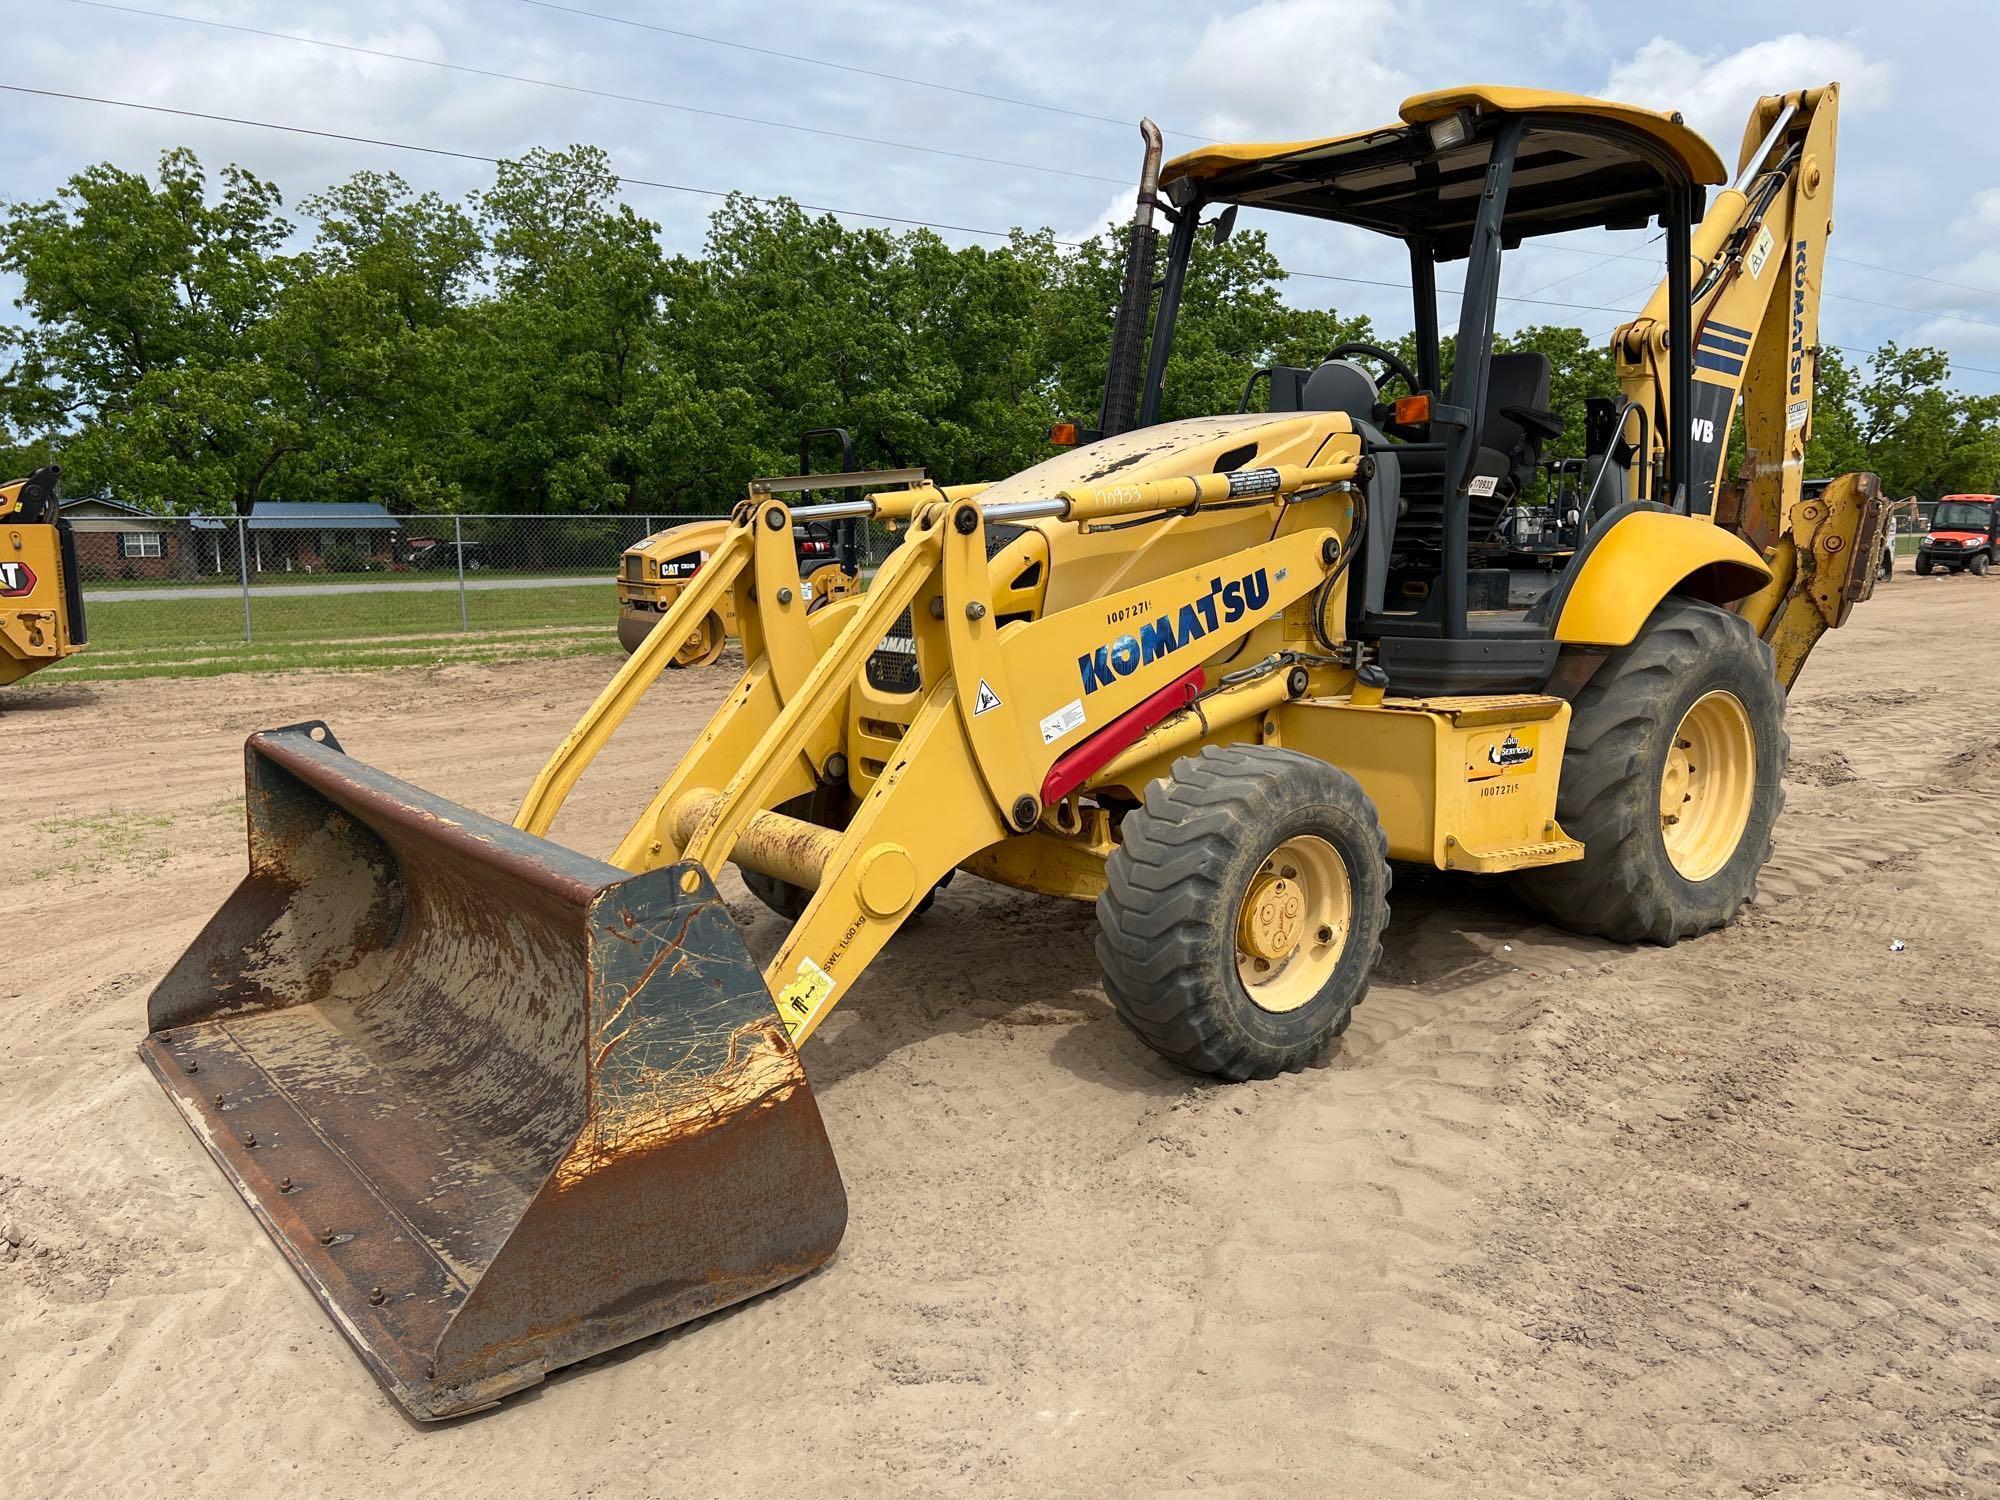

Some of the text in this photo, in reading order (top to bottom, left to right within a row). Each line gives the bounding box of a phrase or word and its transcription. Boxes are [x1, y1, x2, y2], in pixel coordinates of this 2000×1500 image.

[1789, 240, 1807, 396] KOMATSU
[1690, 417, 1714, 444] WB
[661, 563, 680, 576] CAT
[1077, 567, 1270, 696] KOMATSU
[823, 951, 842, 972] SWL
[854, 915, 866, 929] kg
